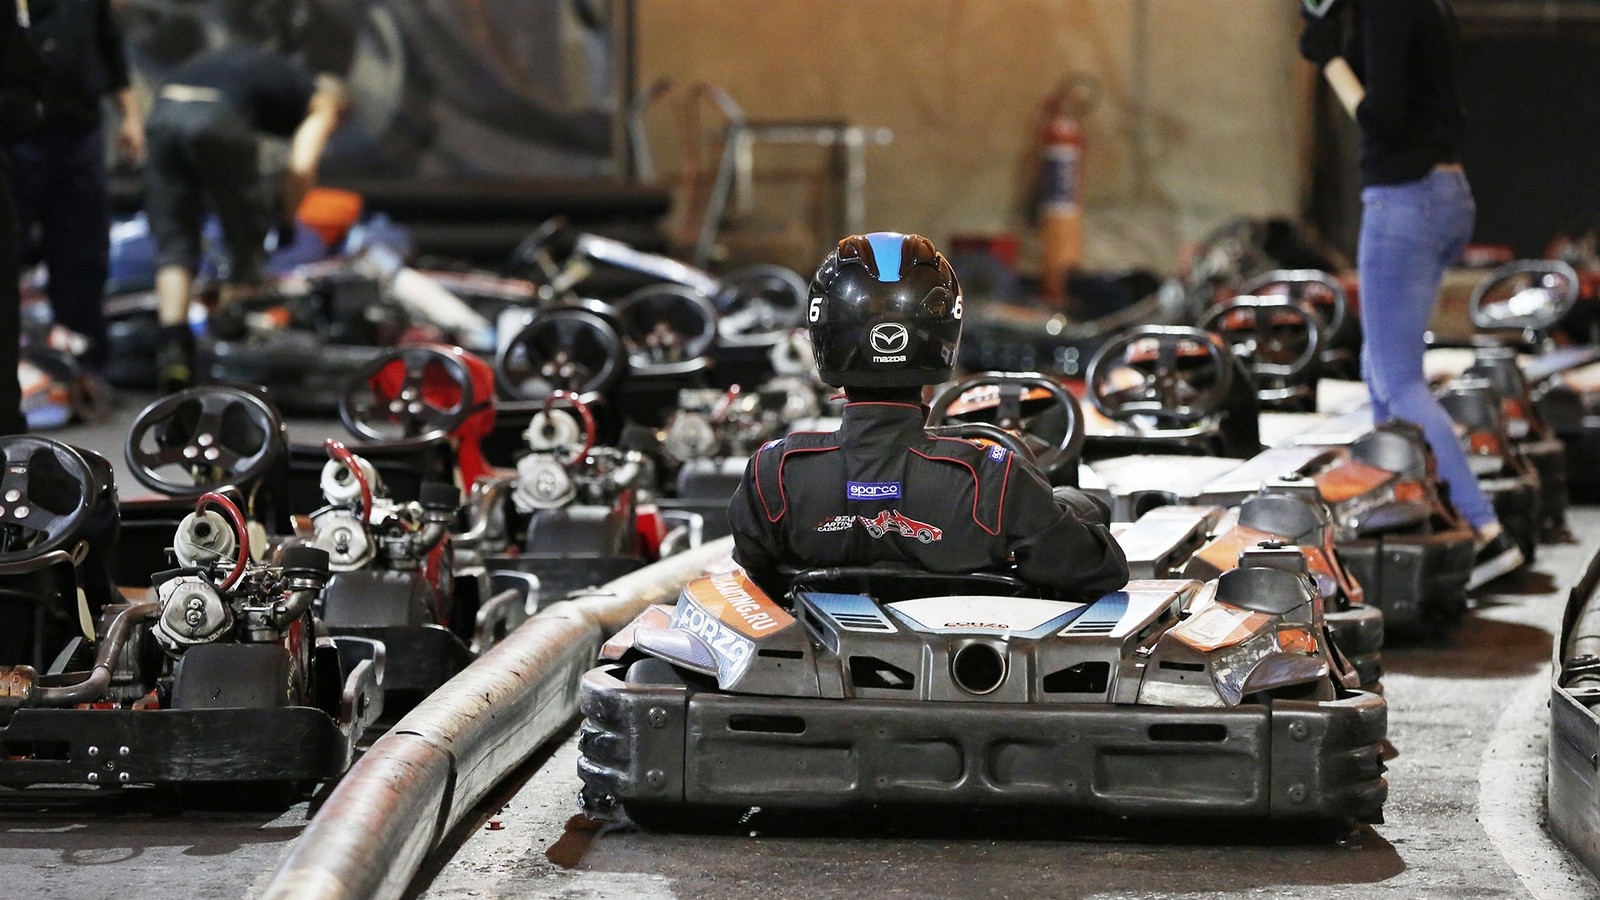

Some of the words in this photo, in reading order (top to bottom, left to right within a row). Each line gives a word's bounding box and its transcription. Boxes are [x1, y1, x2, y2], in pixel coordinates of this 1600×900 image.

[809, 297, 823, 322] 6
[952, 295, 963, 320] 6
[873, 355, 906, 363] mazda
[850, 484, 898, 498] sparco
